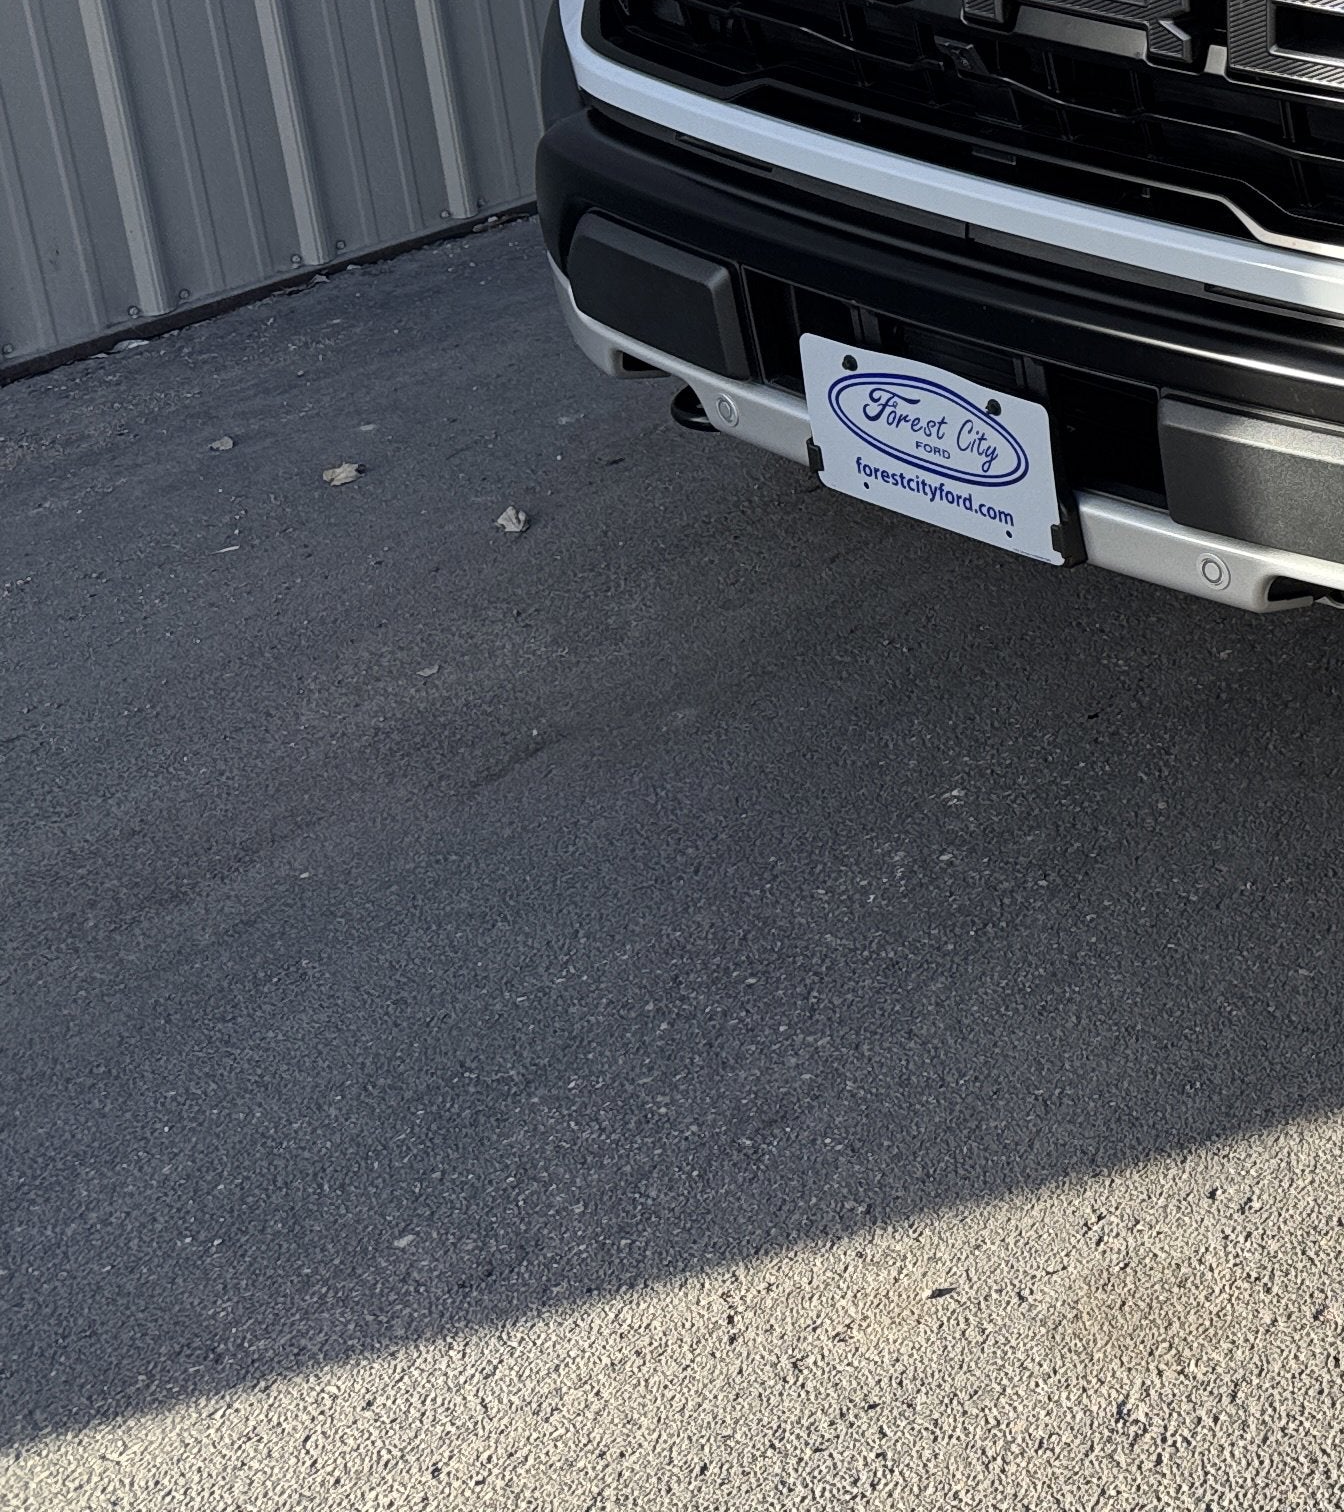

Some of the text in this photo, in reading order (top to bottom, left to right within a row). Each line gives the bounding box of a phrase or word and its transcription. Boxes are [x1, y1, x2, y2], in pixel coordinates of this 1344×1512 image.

[863, 387, 999, 473] Forest City
[915, 440, 951, 460] FORD
[855, 456, 1015, 527] forestcityford.com
